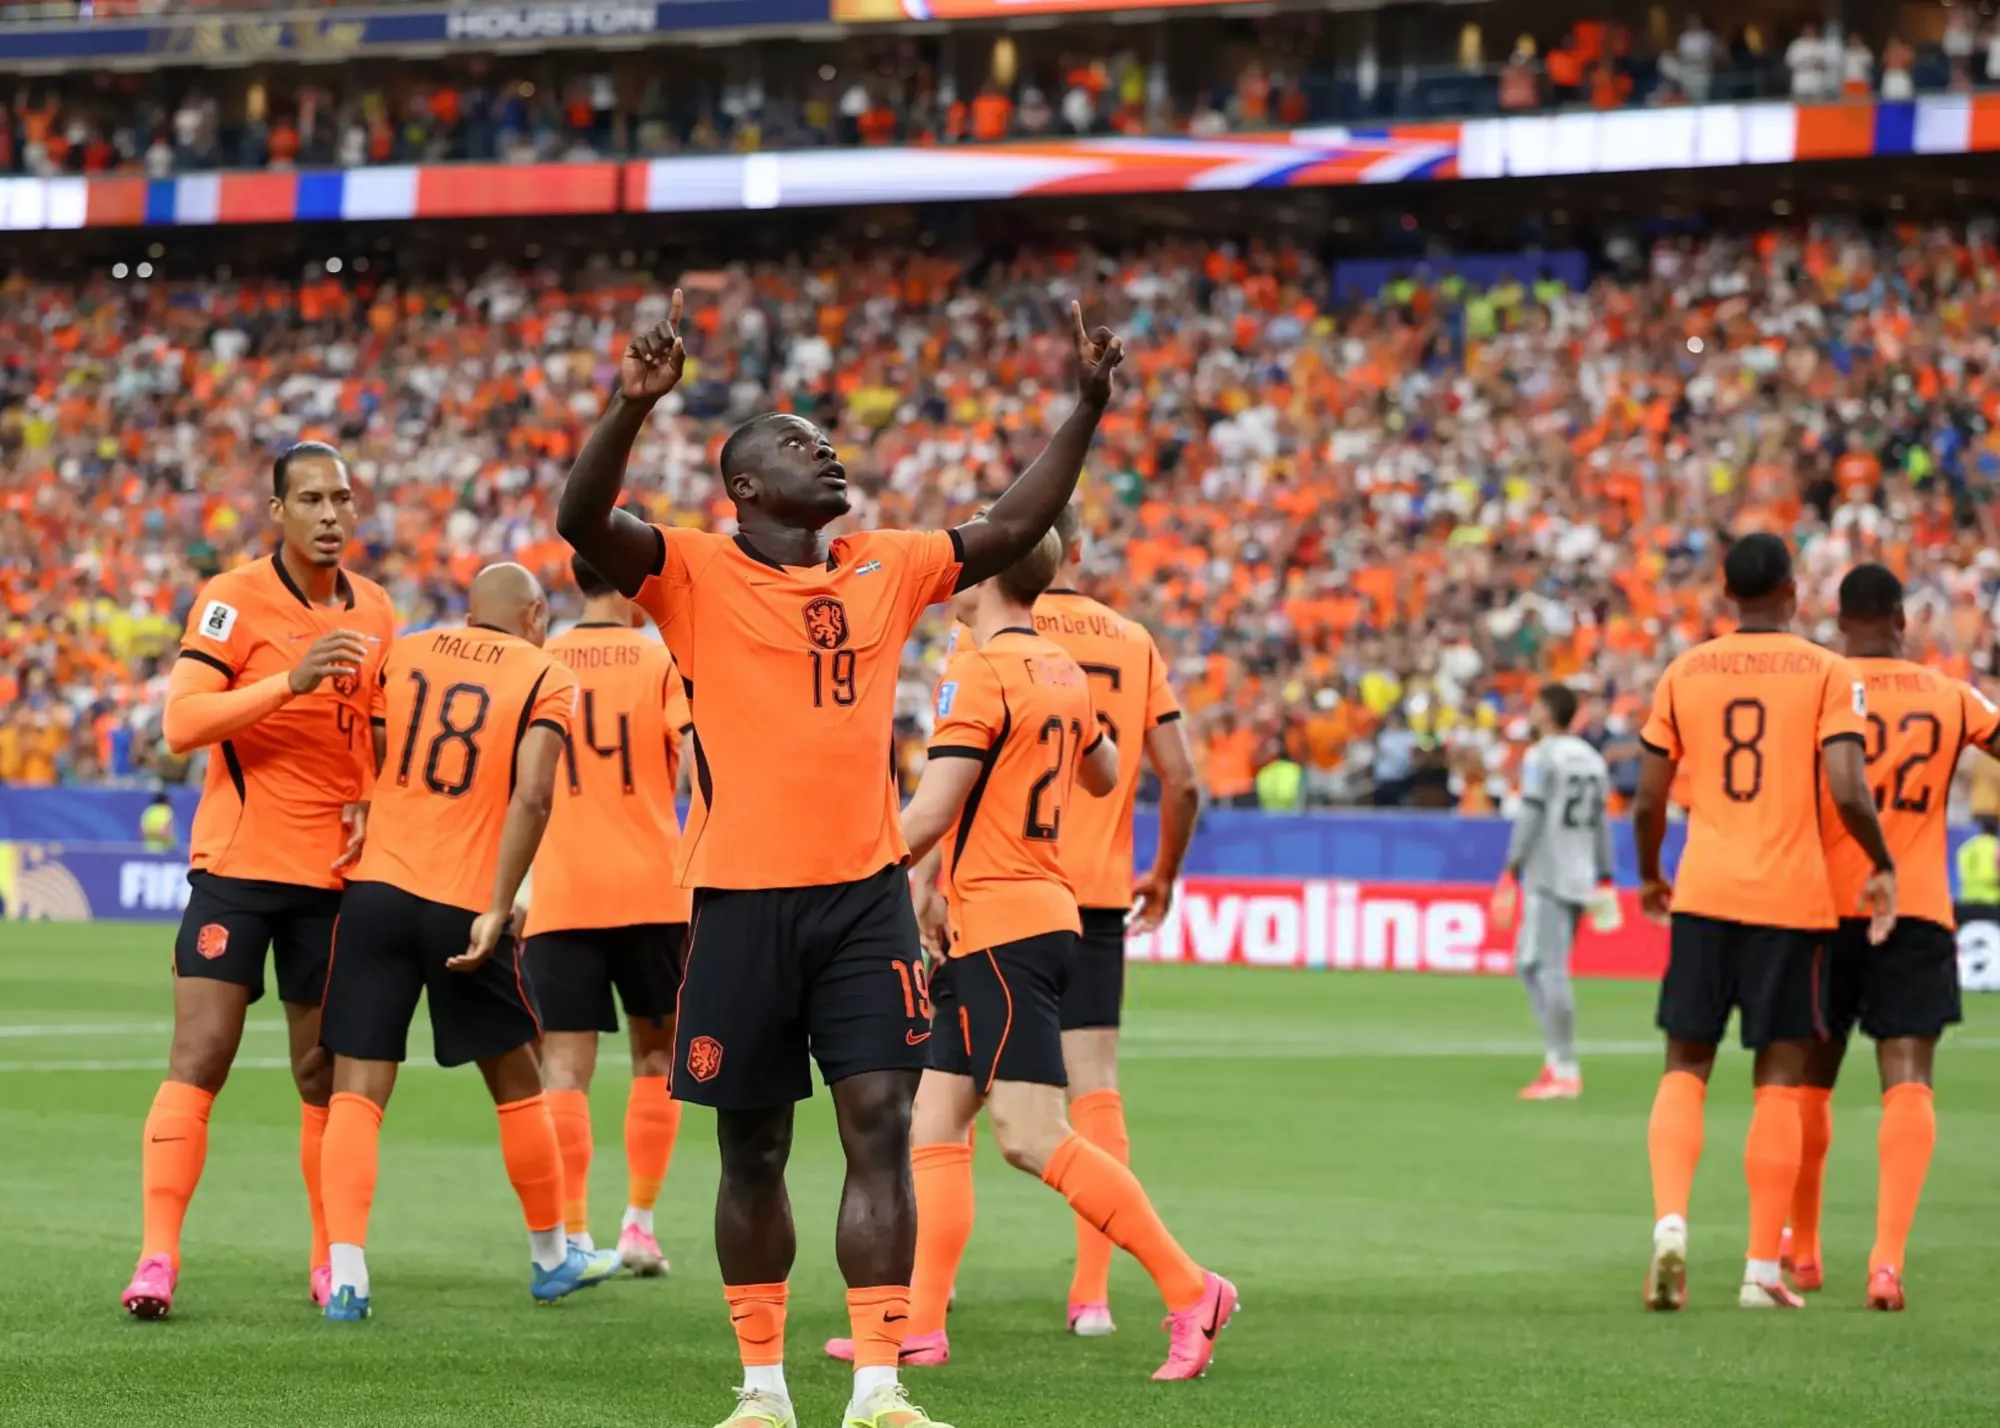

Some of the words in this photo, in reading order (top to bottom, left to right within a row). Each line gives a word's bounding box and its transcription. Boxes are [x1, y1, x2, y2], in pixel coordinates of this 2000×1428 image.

[447, 5, 656, 40] HOUSTON
[431, 633, 505, 665] MALEN
[808, 649, 857, 708] 19
[337, 702, 355, 750] 4
[396, 667, 490, 798] 18
[1722, 697, 1766, 803] 8
[1864, 711, 1942, 814] 22
[1023, 714, 1083, 842] 21
